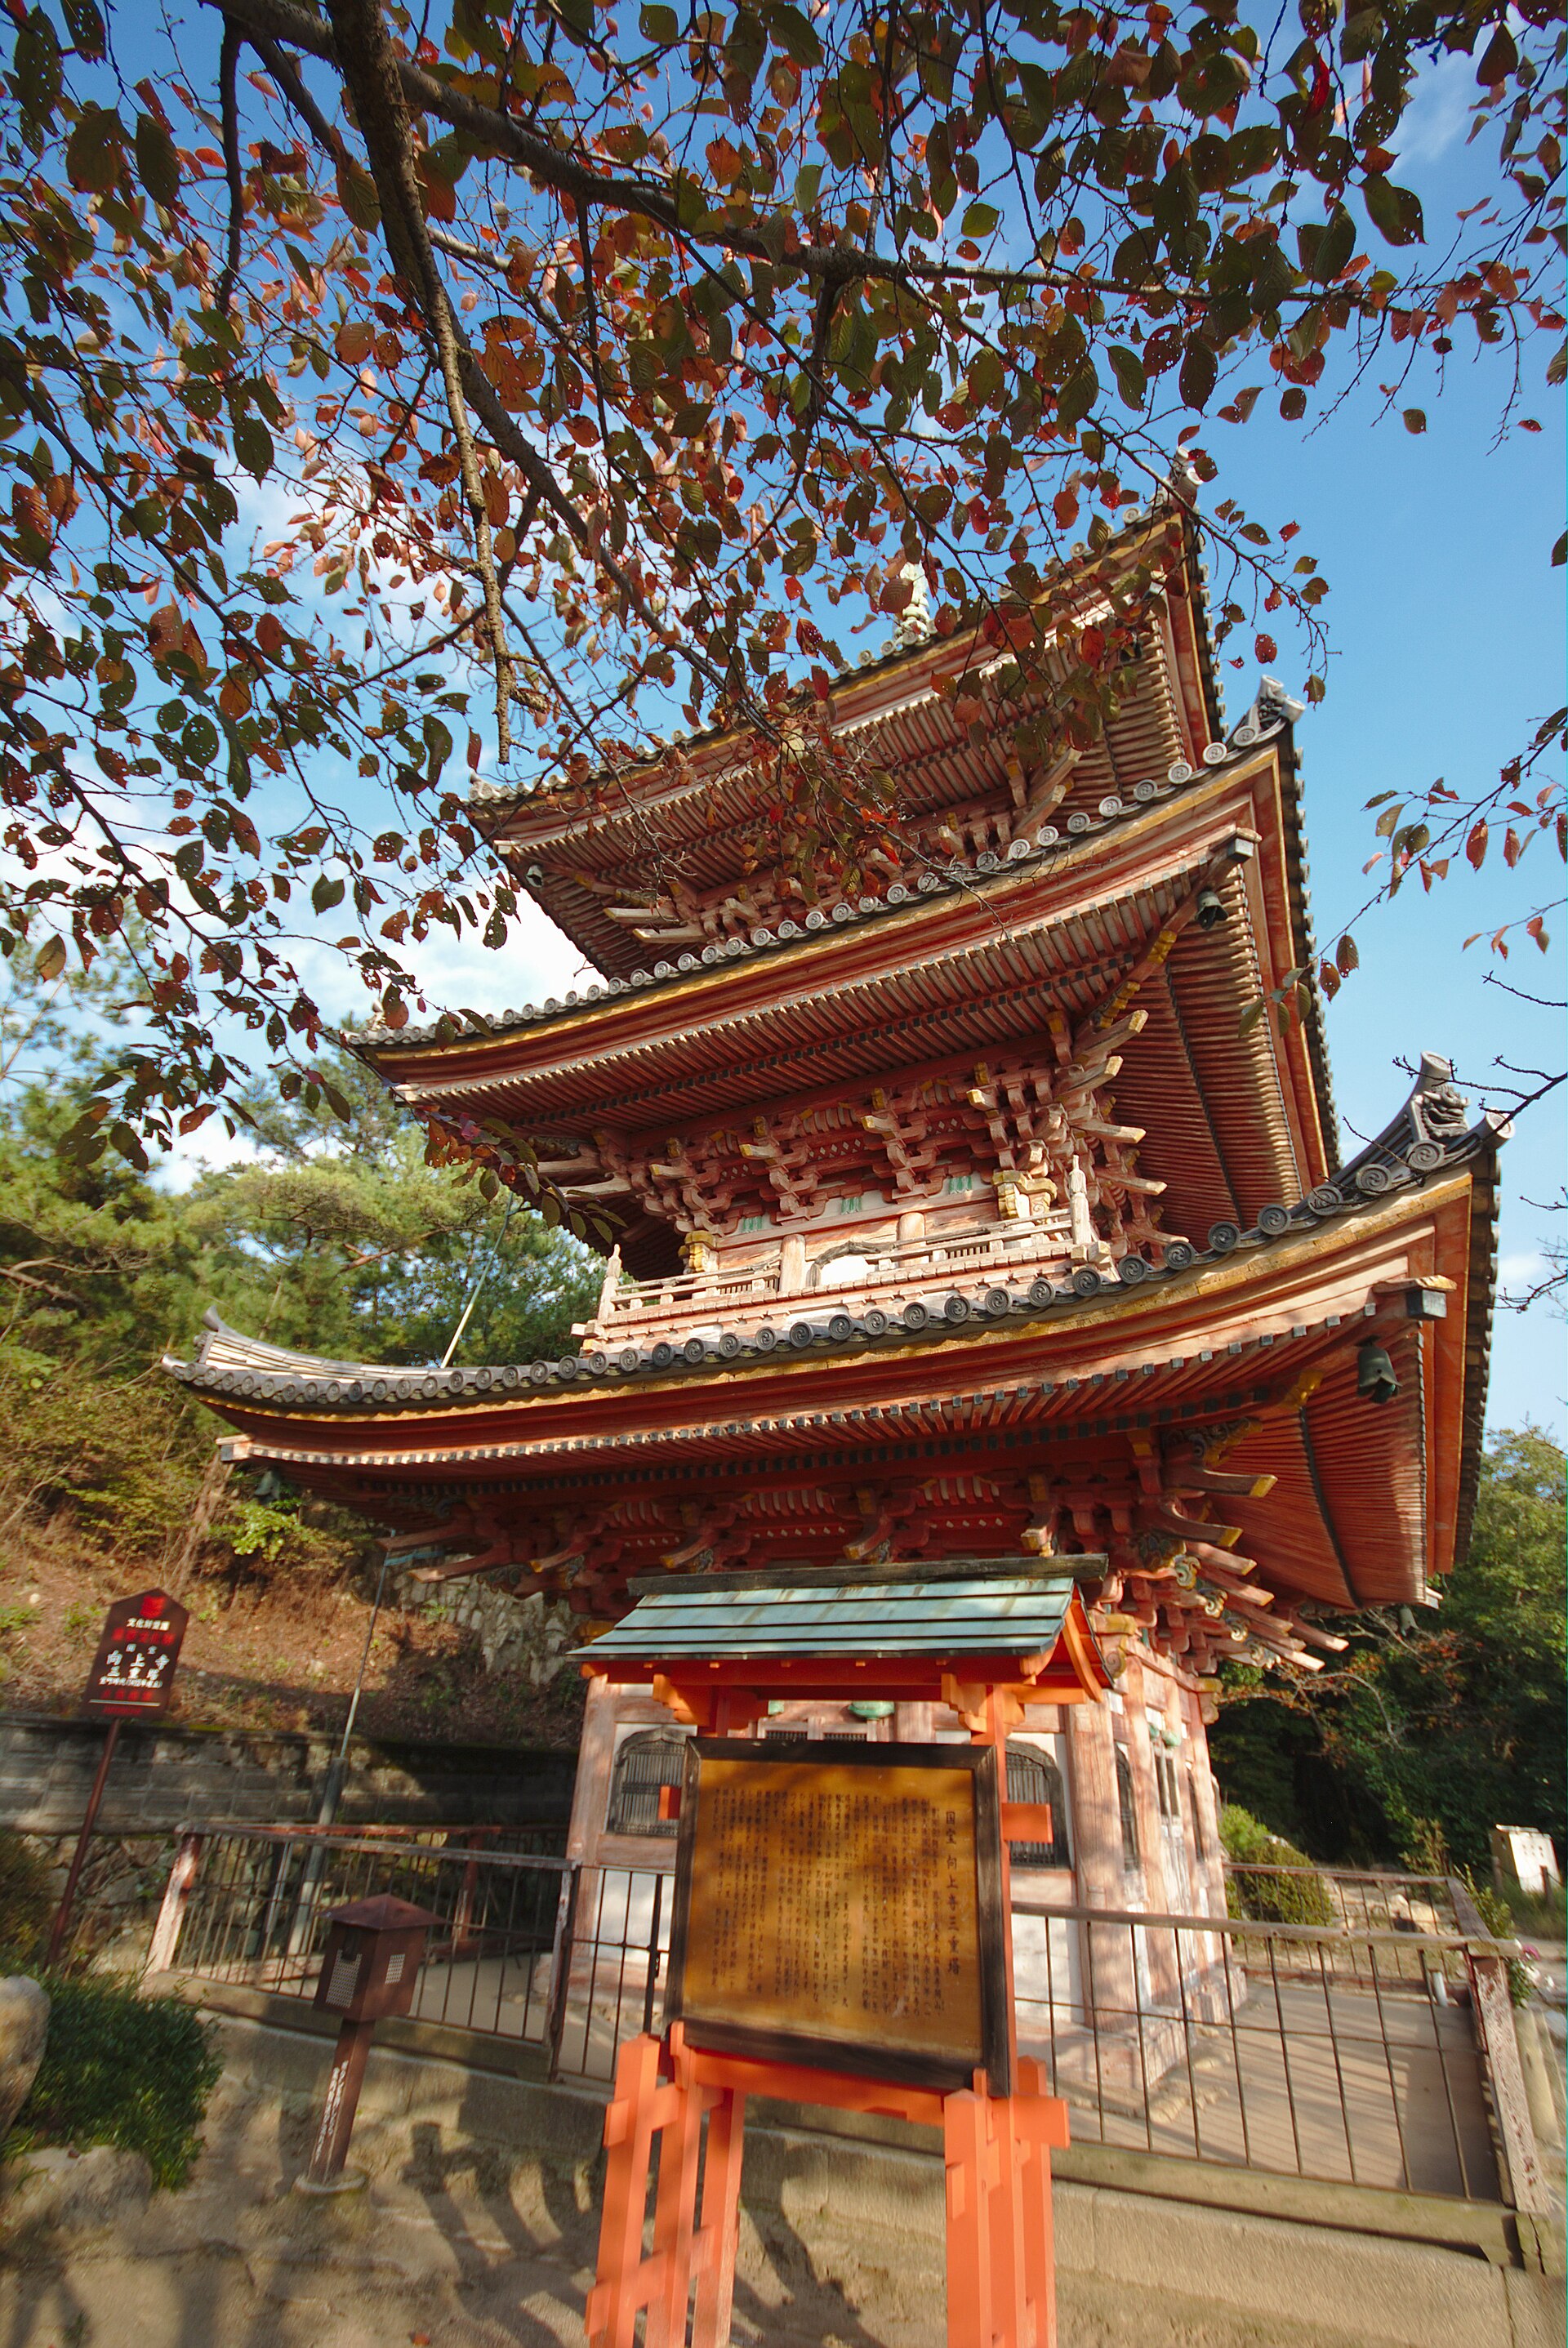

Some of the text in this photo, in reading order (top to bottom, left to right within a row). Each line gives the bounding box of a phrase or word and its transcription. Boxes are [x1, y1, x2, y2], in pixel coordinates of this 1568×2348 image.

[106, 1650, 171, 1670] 向上寺
[107, 1666, 161, 1680] 三重塔
[946, 1811, 961, 1976] 国宝 向上寺三重塔
